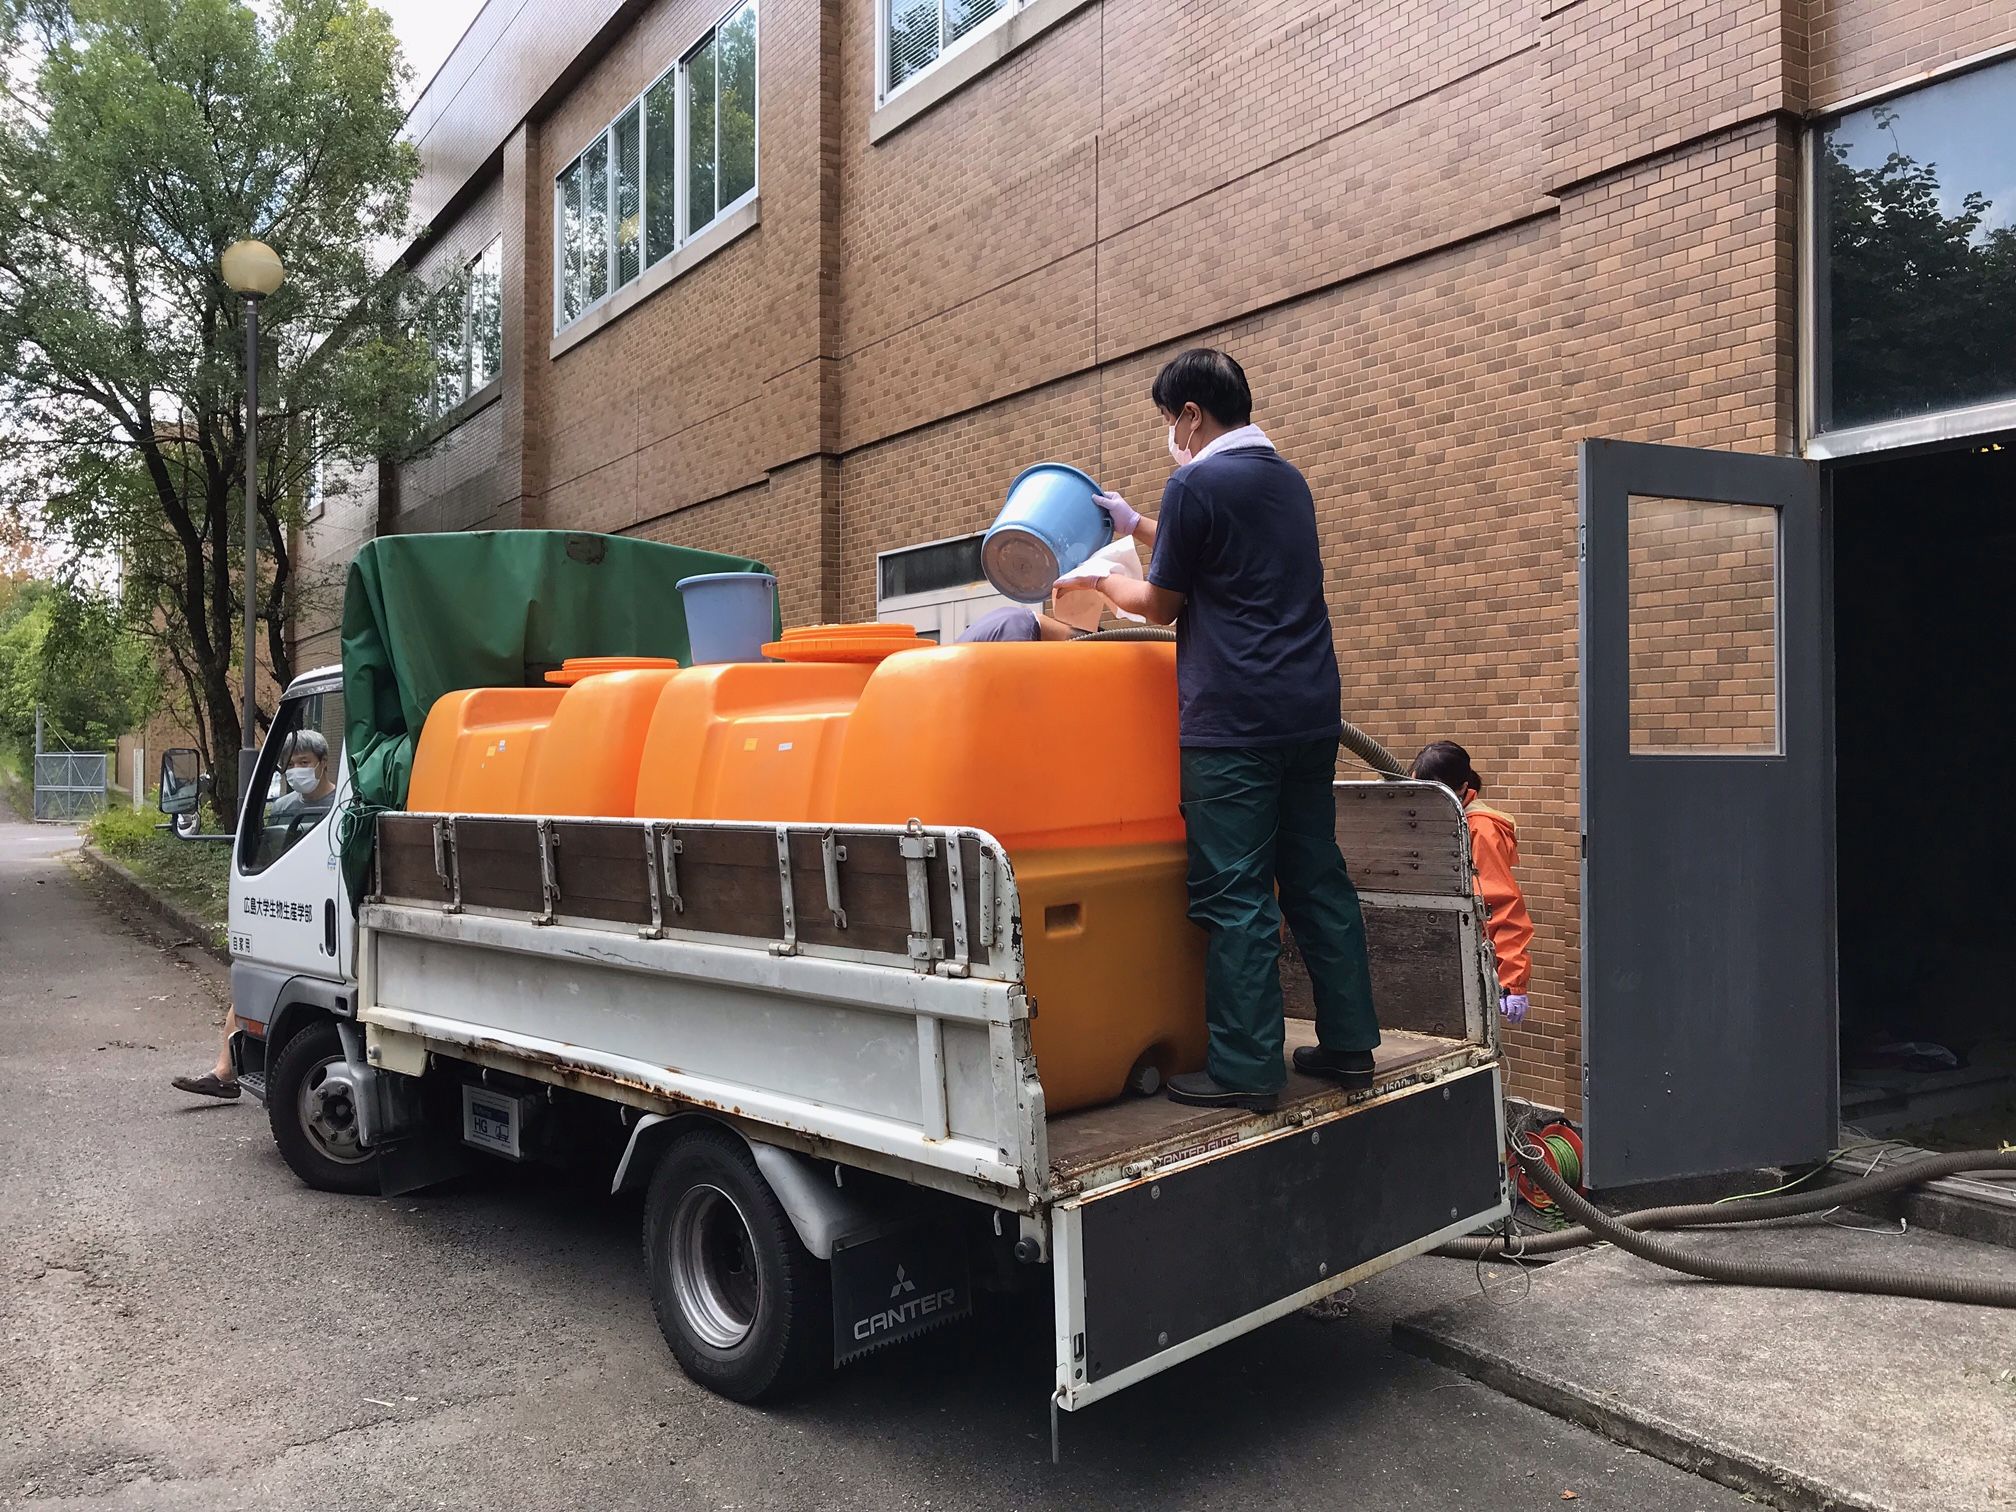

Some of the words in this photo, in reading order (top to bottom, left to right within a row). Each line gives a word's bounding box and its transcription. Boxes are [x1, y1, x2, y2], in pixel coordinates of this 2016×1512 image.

[243, 896, 313, 923] 広島大学生物生産学部
[474, 1117, 488, 1133] HG
[853, 1288, 956, 1341] CANTER
